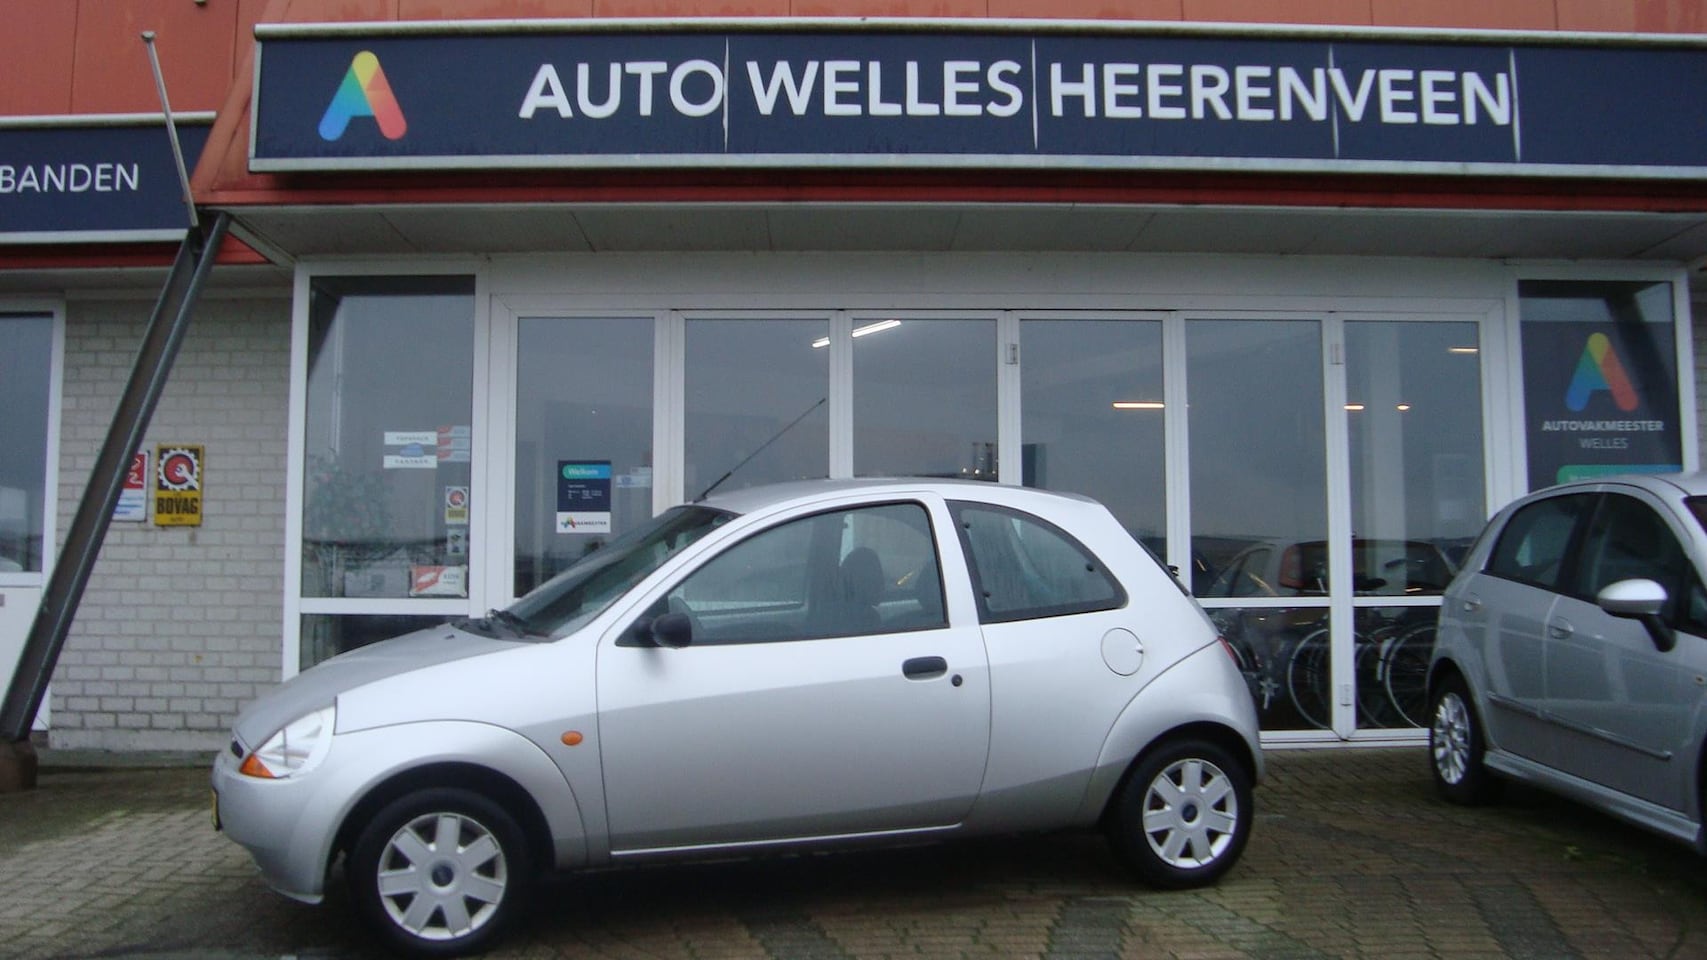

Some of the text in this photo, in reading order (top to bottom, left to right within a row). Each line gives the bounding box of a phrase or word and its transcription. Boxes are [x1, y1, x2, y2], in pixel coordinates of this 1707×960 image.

[518, 59, 1510, 125] AUTO WELLES HEERENVEEN
[0, 163, 139, 193] BANDEN
[1542, 420, 1664, 432] AUTOVAKMEESTER
[1578, 438, 1629, 449] WELLES
[157, 497, 198, 514] BOVAG
